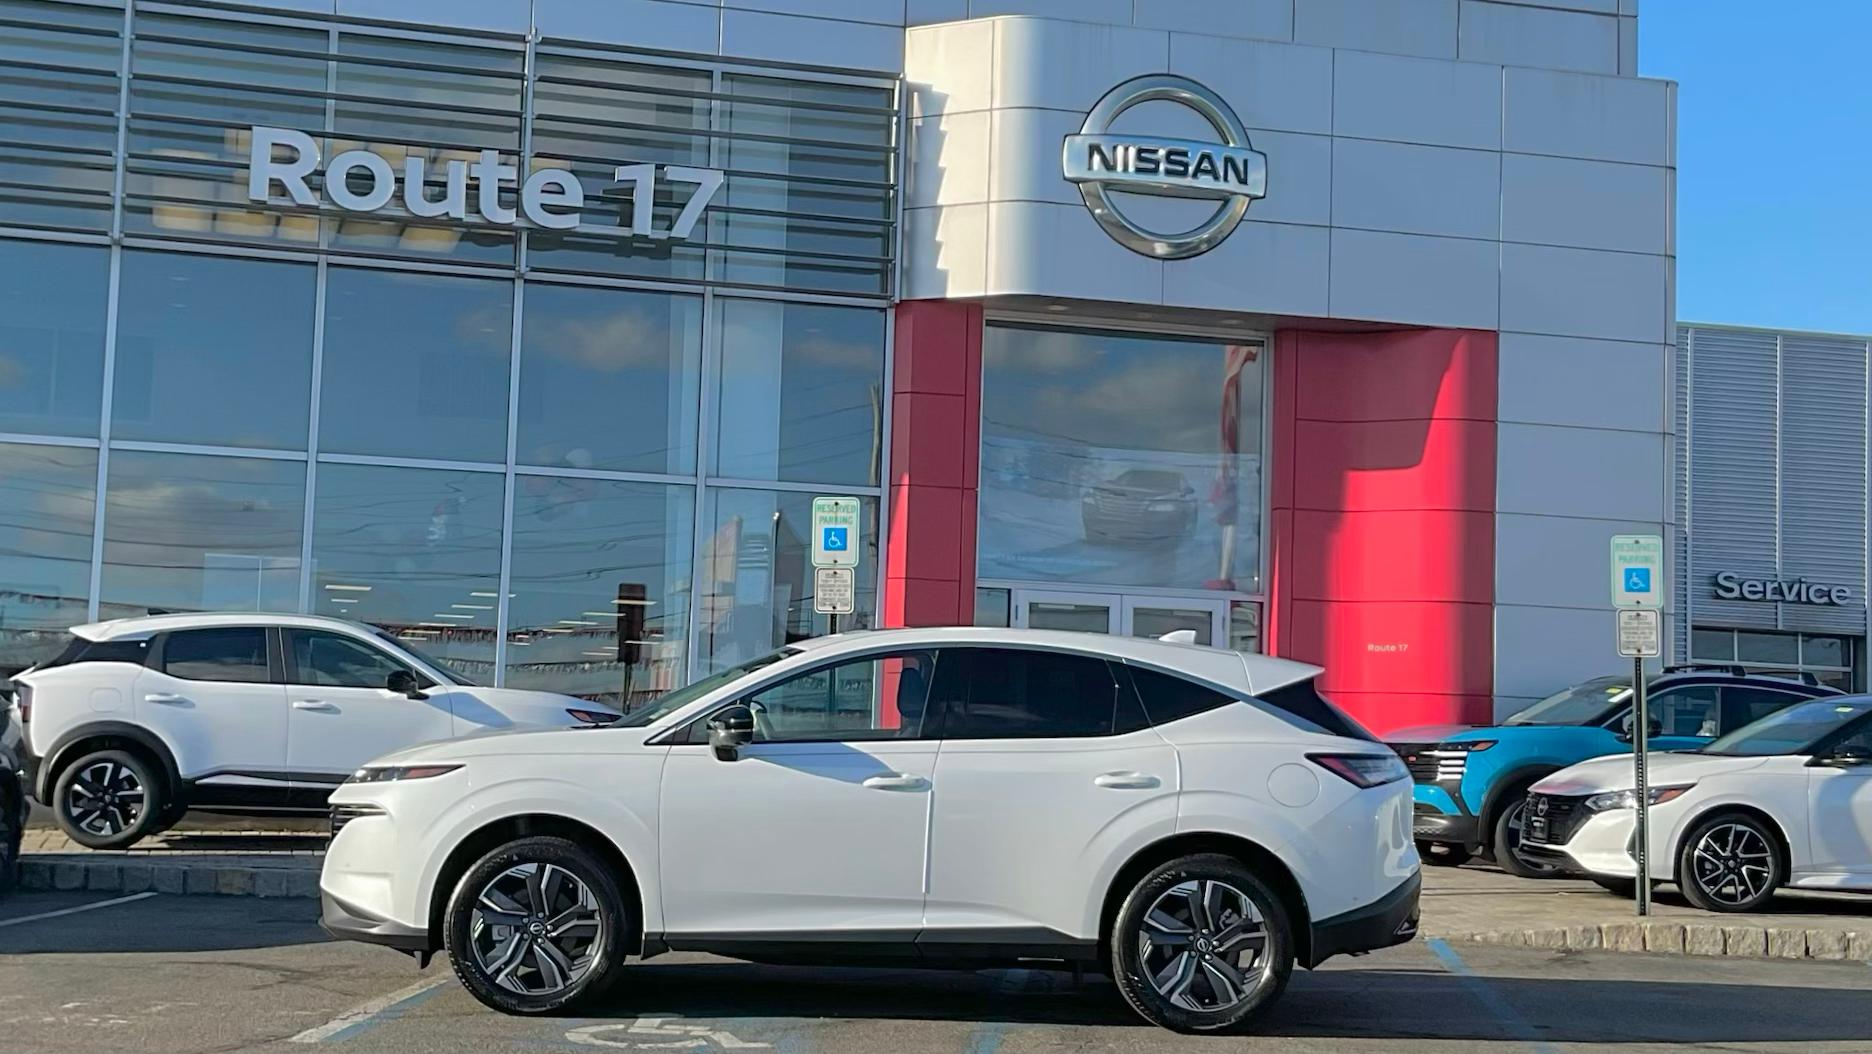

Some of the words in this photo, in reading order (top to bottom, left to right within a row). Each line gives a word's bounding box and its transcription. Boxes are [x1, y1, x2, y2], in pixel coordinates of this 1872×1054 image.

[1088, 143, 1249, 186] NISSAN
[249, 125, 584, 229] Route
[614, 163, 724, 238] 17
[816, 504, 856, 513] RESERVED
[819, 515, 854, 525] PARKING
[1714, 571, 1852, 605] Service
[1367, 643, 1397, 652] Route
[1398, 643, 1408, 652] 17
